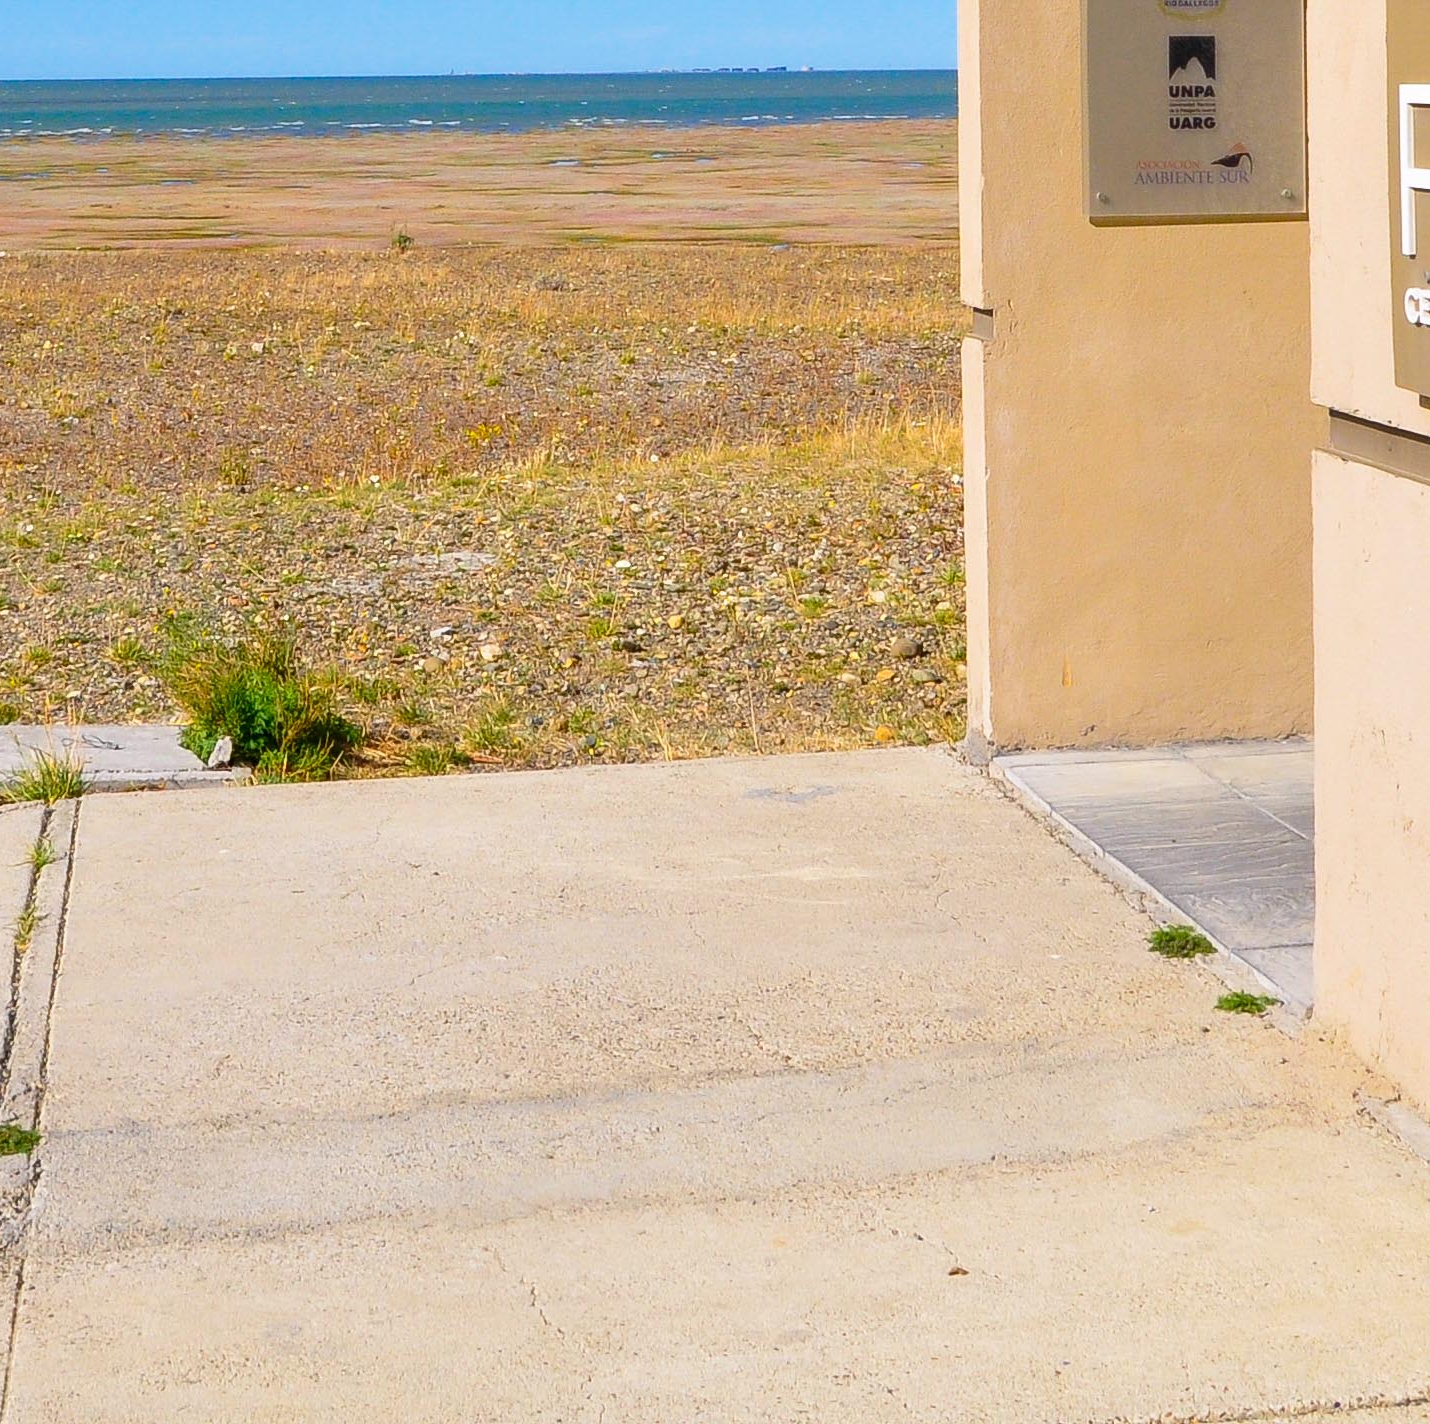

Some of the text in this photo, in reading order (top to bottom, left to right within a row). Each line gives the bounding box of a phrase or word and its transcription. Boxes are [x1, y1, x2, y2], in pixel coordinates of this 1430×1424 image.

[1169, 85, 1216, 98] UNPA
[1169, 117, 1216, 129] UARG
[1134, 170, 1250, 184] AMBIENTE SUR
